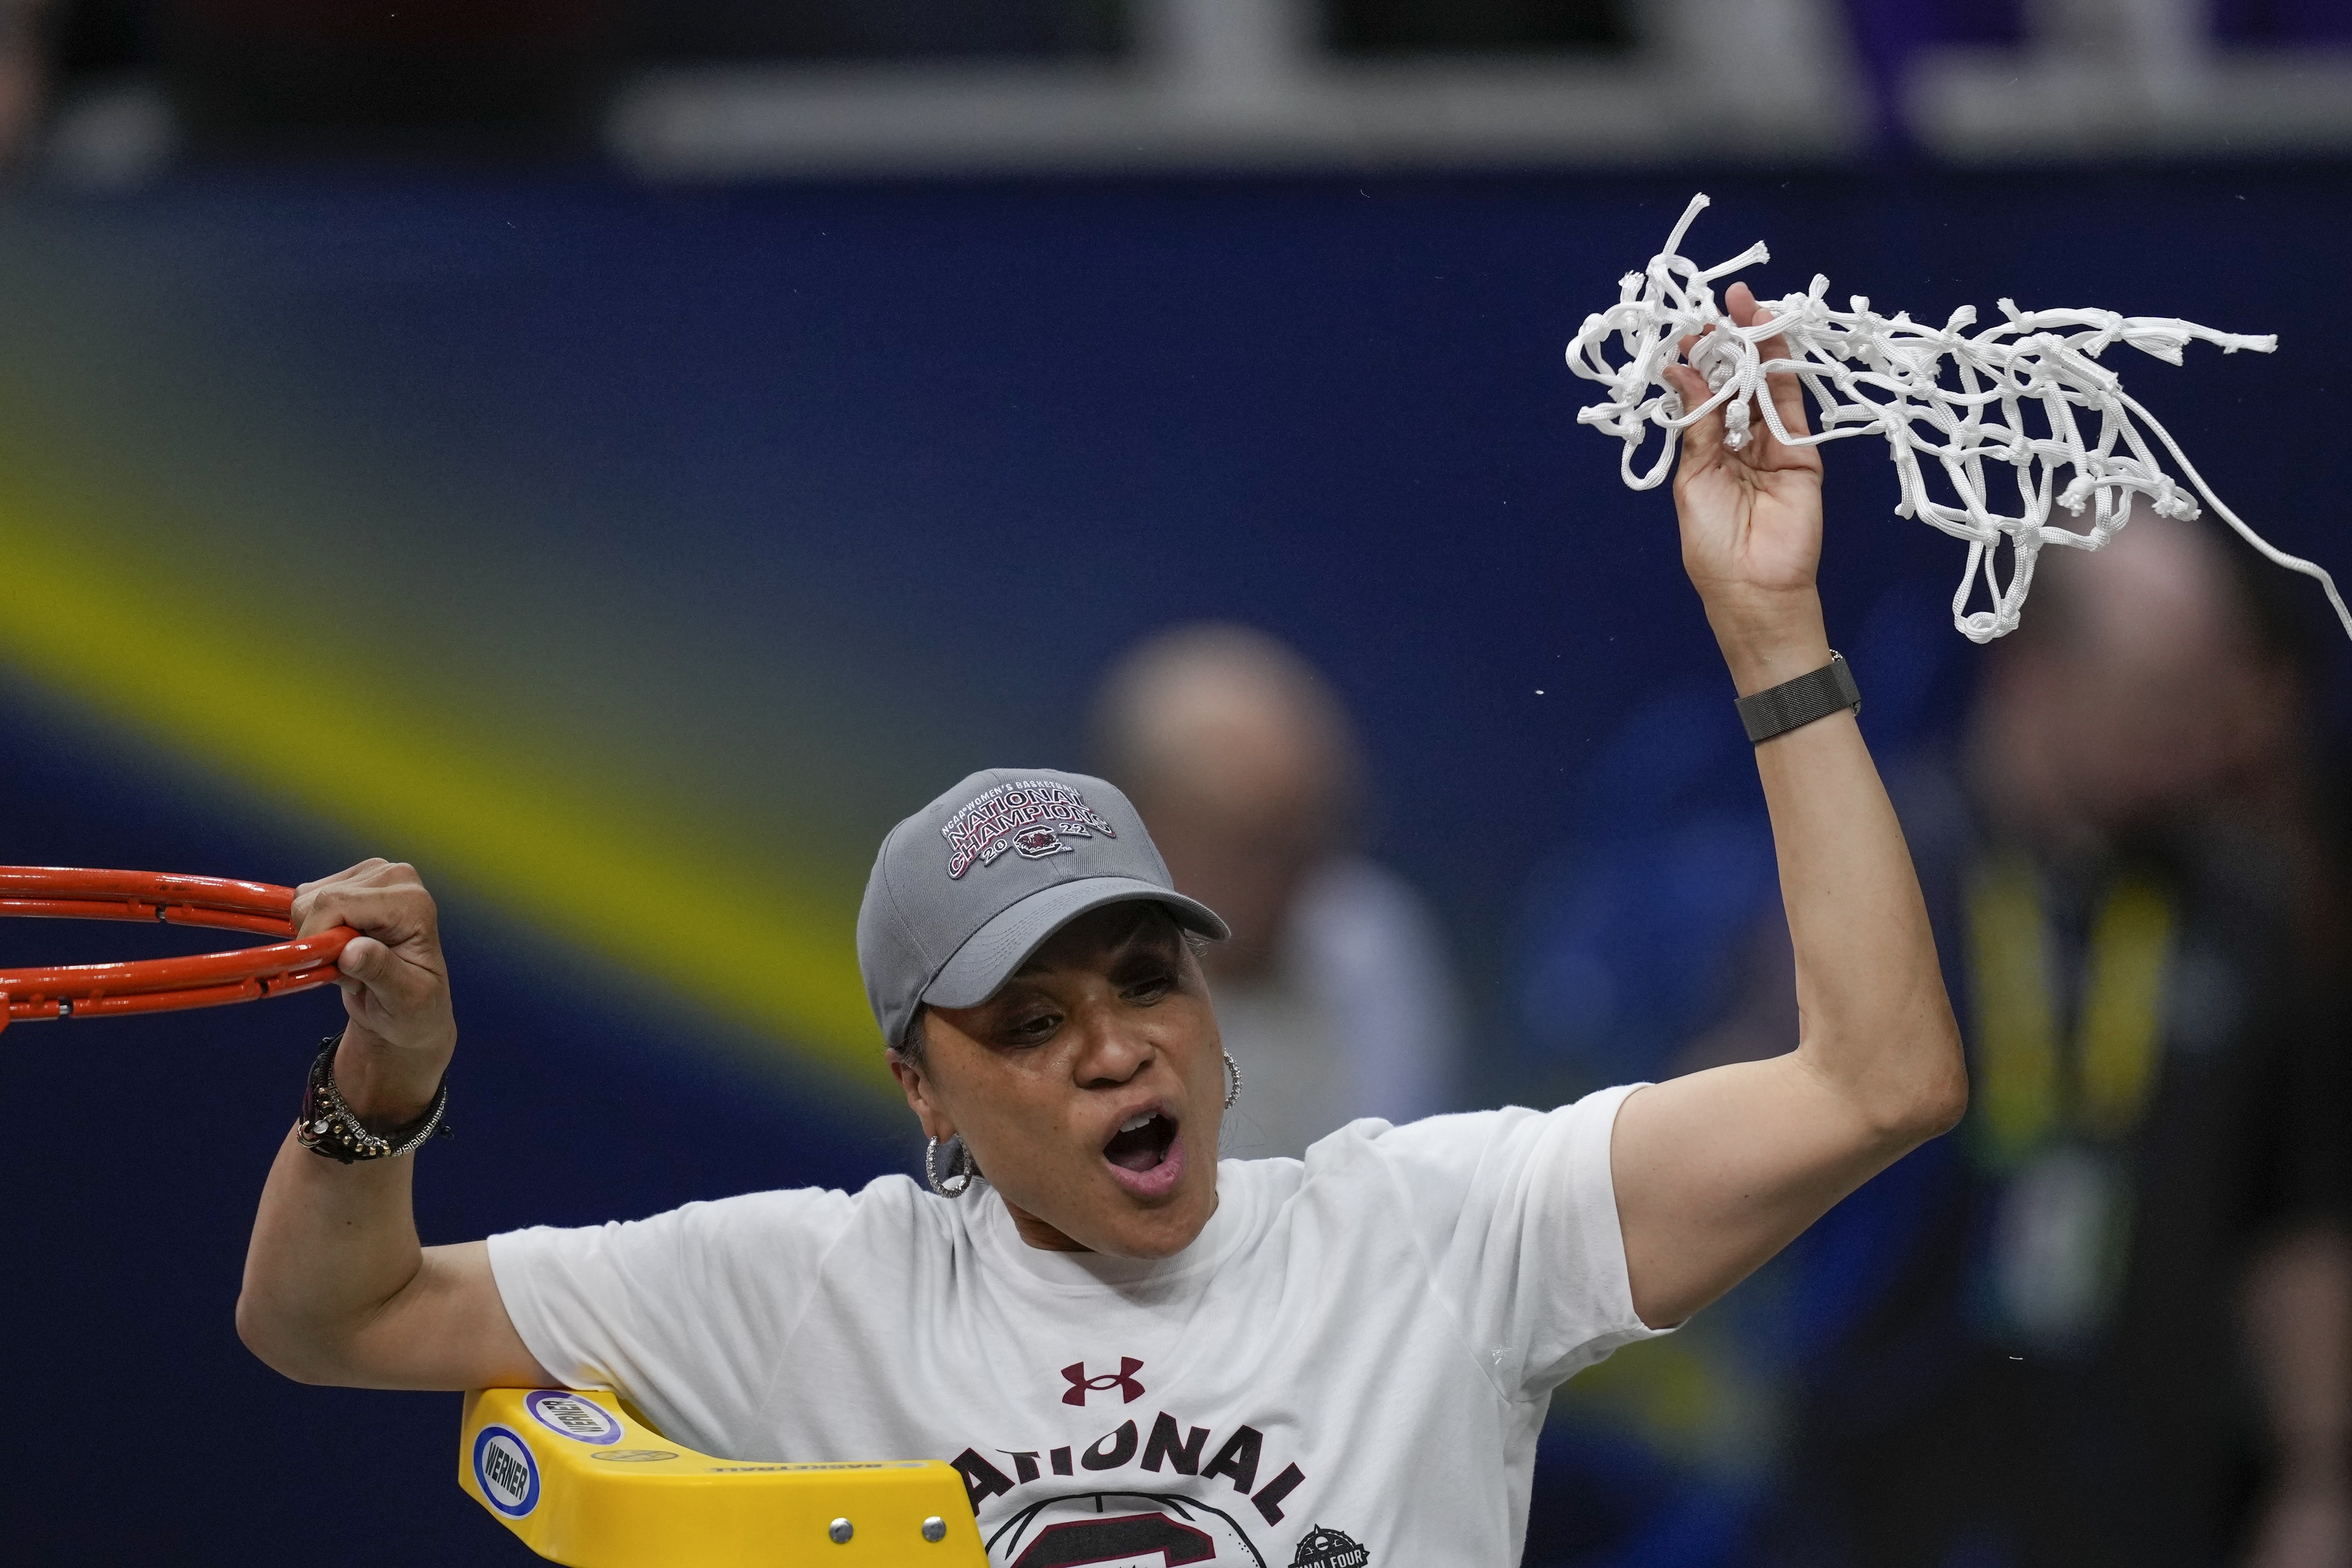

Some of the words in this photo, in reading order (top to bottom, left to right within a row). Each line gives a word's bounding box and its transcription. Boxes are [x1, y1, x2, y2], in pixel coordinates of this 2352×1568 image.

[966, 783, 1013, 811] WOMEN'S
[1015, 780, 1081, 795] BASKETBALL
[947, 788, 1091, 851] NATIONAL
[948, 804, 1114, 878] CHAMPIONS
[541, 1400, 605, 1433] WERNER
[485, 1441, 528, 1501] WERNER
[1330, 1549, 1363, 1568] FOUR
